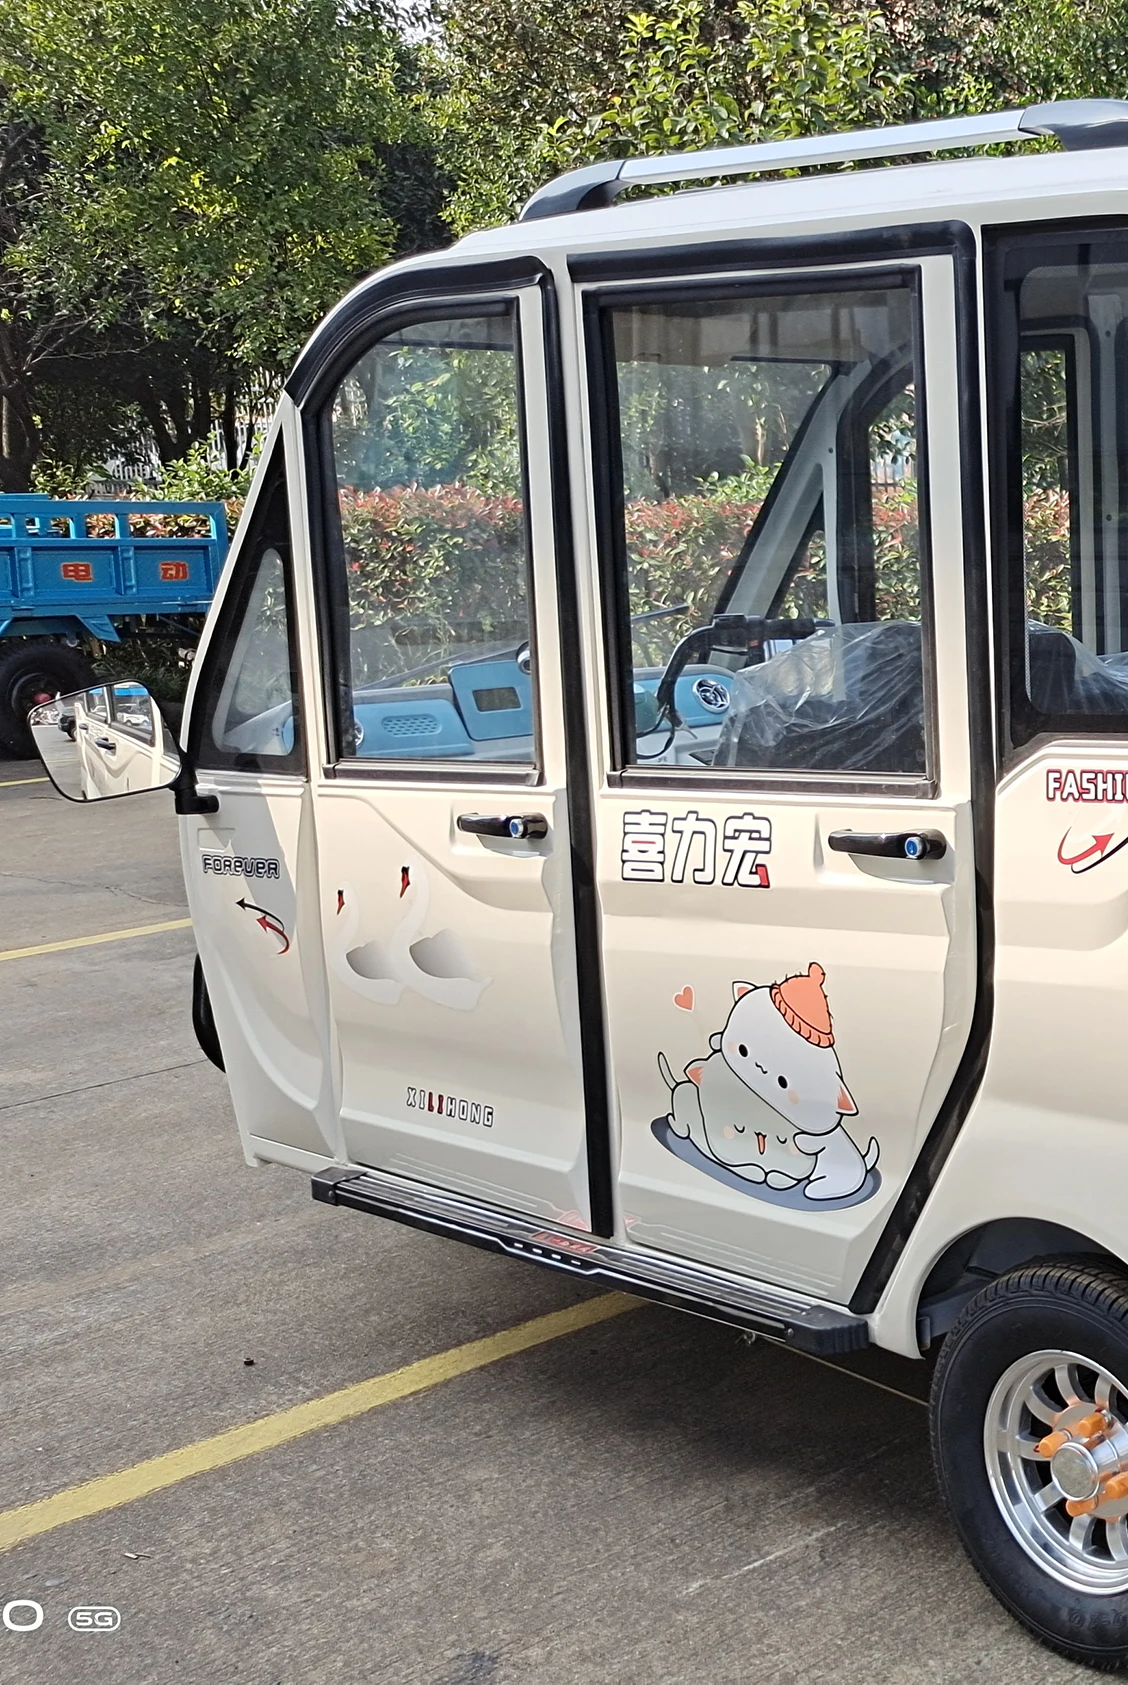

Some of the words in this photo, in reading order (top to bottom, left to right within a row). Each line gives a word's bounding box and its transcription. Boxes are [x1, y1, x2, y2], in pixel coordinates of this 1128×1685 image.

[202, 854, 280, 879] FOREVER
[621, 809, 772, 888] 喜力宏
[406, 1086, 494, 1128] XILIHONG
